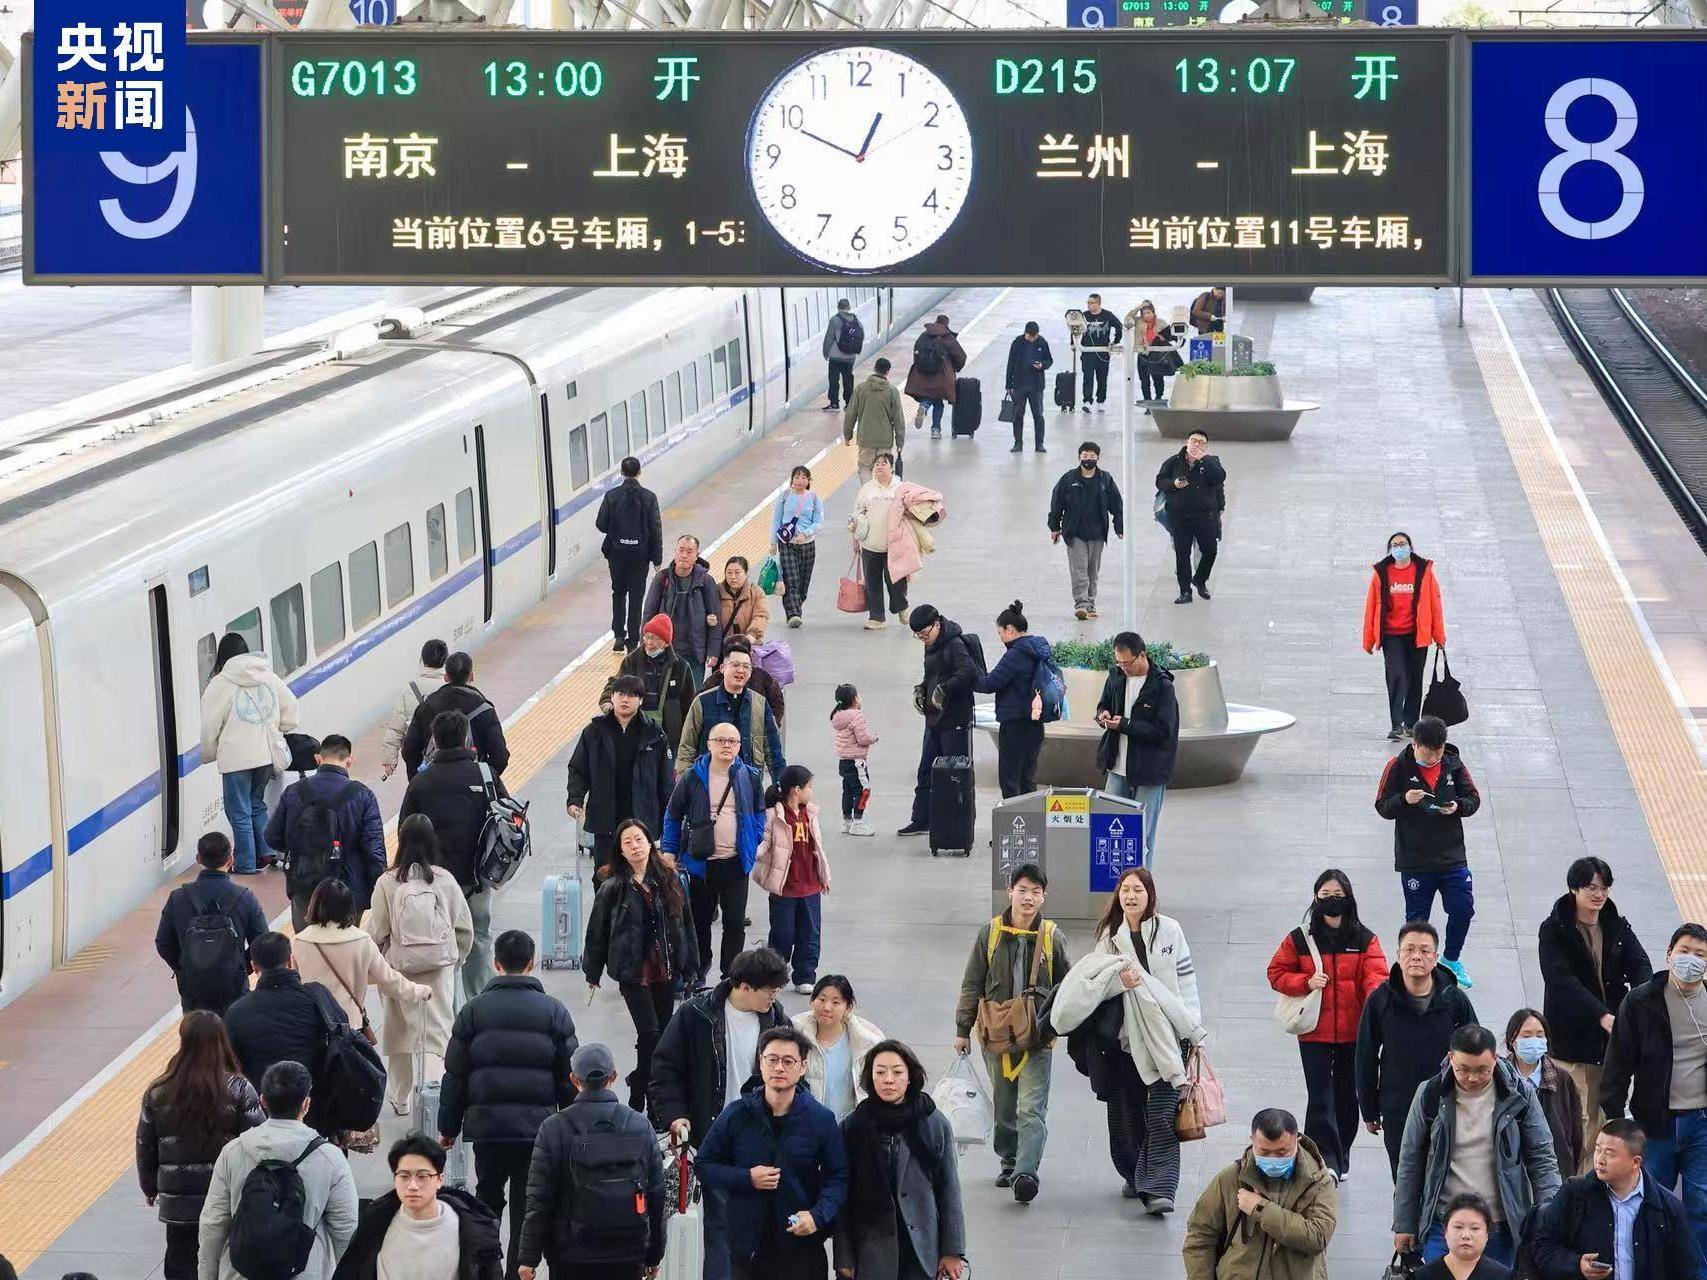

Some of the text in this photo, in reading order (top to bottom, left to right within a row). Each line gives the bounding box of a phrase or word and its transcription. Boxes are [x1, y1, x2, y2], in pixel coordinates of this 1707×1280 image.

[353, 0, 388, 25] 10
[1122, 1, 1150, 10] G7013
[1163, 1, 1189, 10] 13:00
[291, 57, 701, 102] G7013 13:00 开
[847, 61, 872, 87] 12
[898, 73, 906, 98] 1
[995, 55, 1399, 101] D215 13:07 开
[780, 104, 804, 129] 10
[924, 102, 940, 127] 2
[343, 132, 439, 179] 南京
[592, 133, 689, 179] 上海
[766, 144, 781, 169] 9
[937, 145, 953, 170] 3
[1036, 133, 1131, 179] 兰州
[1291, 130, 1390, 177] 上海
[1537, 77, 1645, 240] 8
[780, 184, 797, 209] 8
[922, 187, 939, 213] 4
[392, 215, 745, 251] 当前位置6号车厢，1-5
[817, 213, 832, 239] 7
[851, 225, 867, 251] 6
[892, 216, 908, 241] 5
